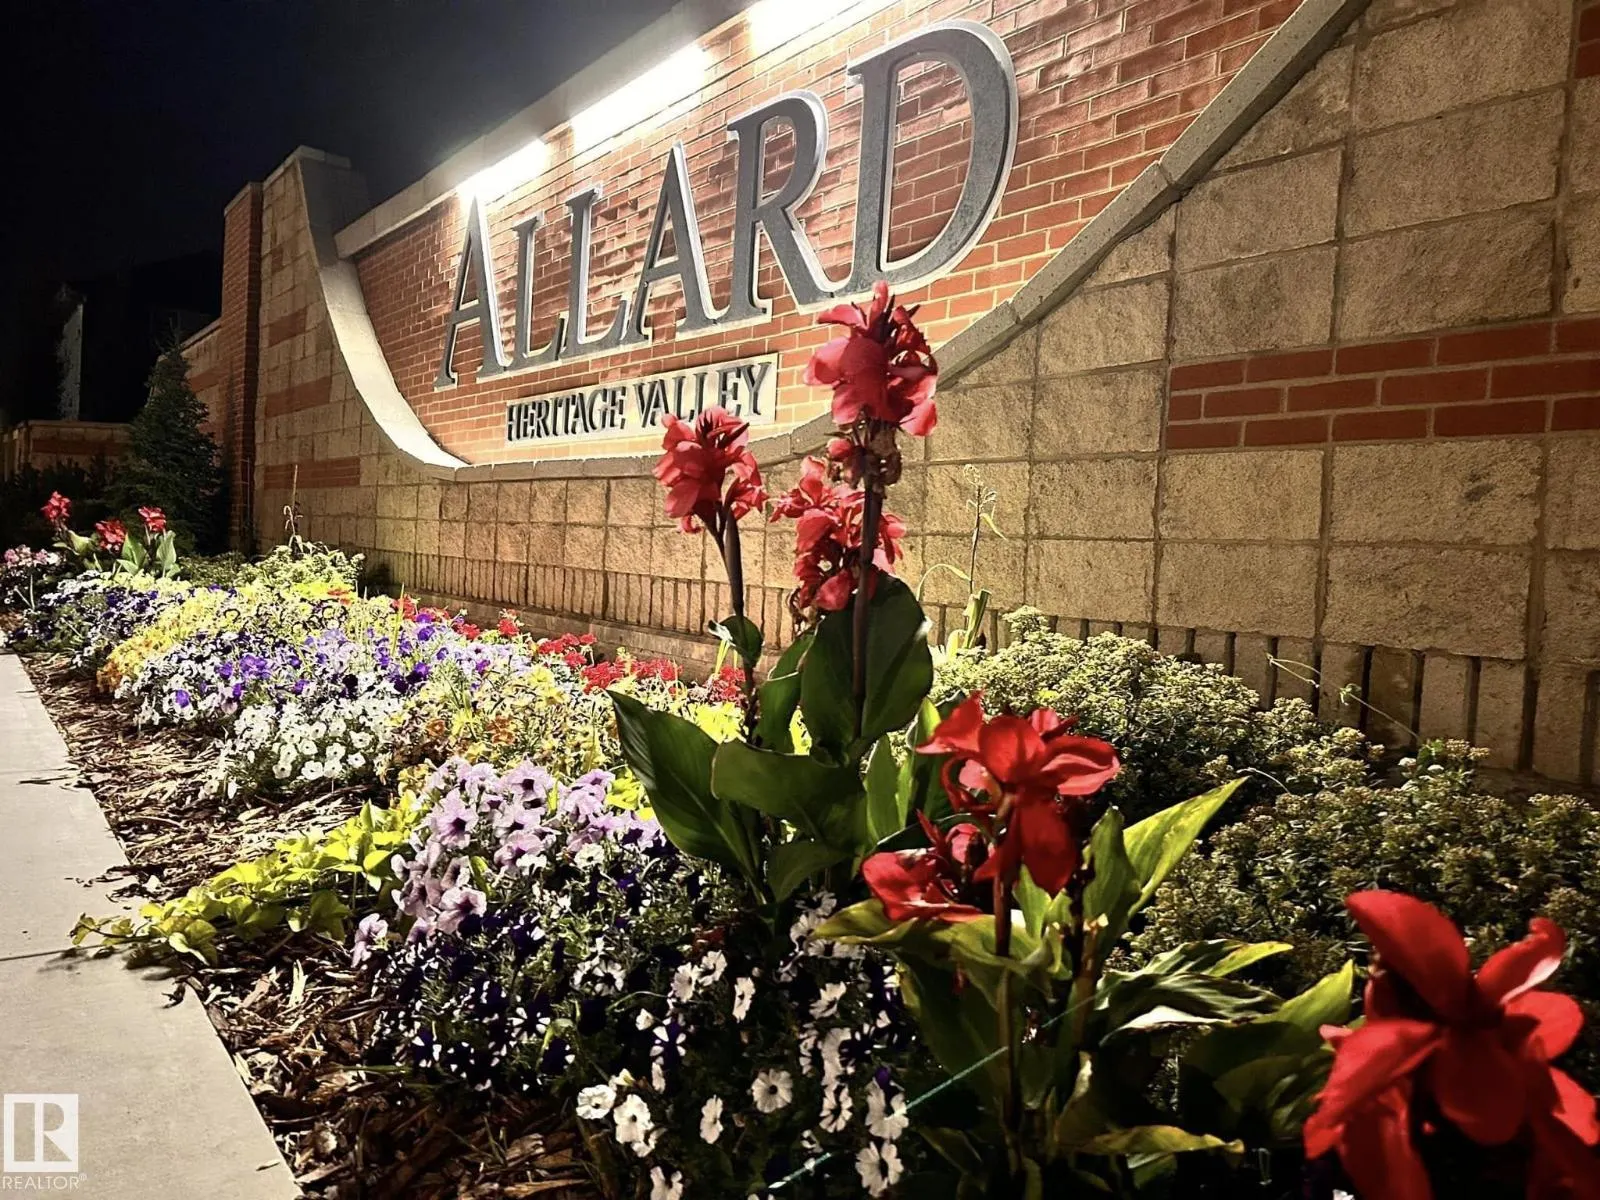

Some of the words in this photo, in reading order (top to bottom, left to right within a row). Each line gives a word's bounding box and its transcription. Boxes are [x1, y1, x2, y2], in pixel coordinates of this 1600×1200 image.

[433, 19, 1018, 391] ALLARD
[507, 386, 626, 441] HERITAGE
[633, 361, 772, 428] VALLEY
